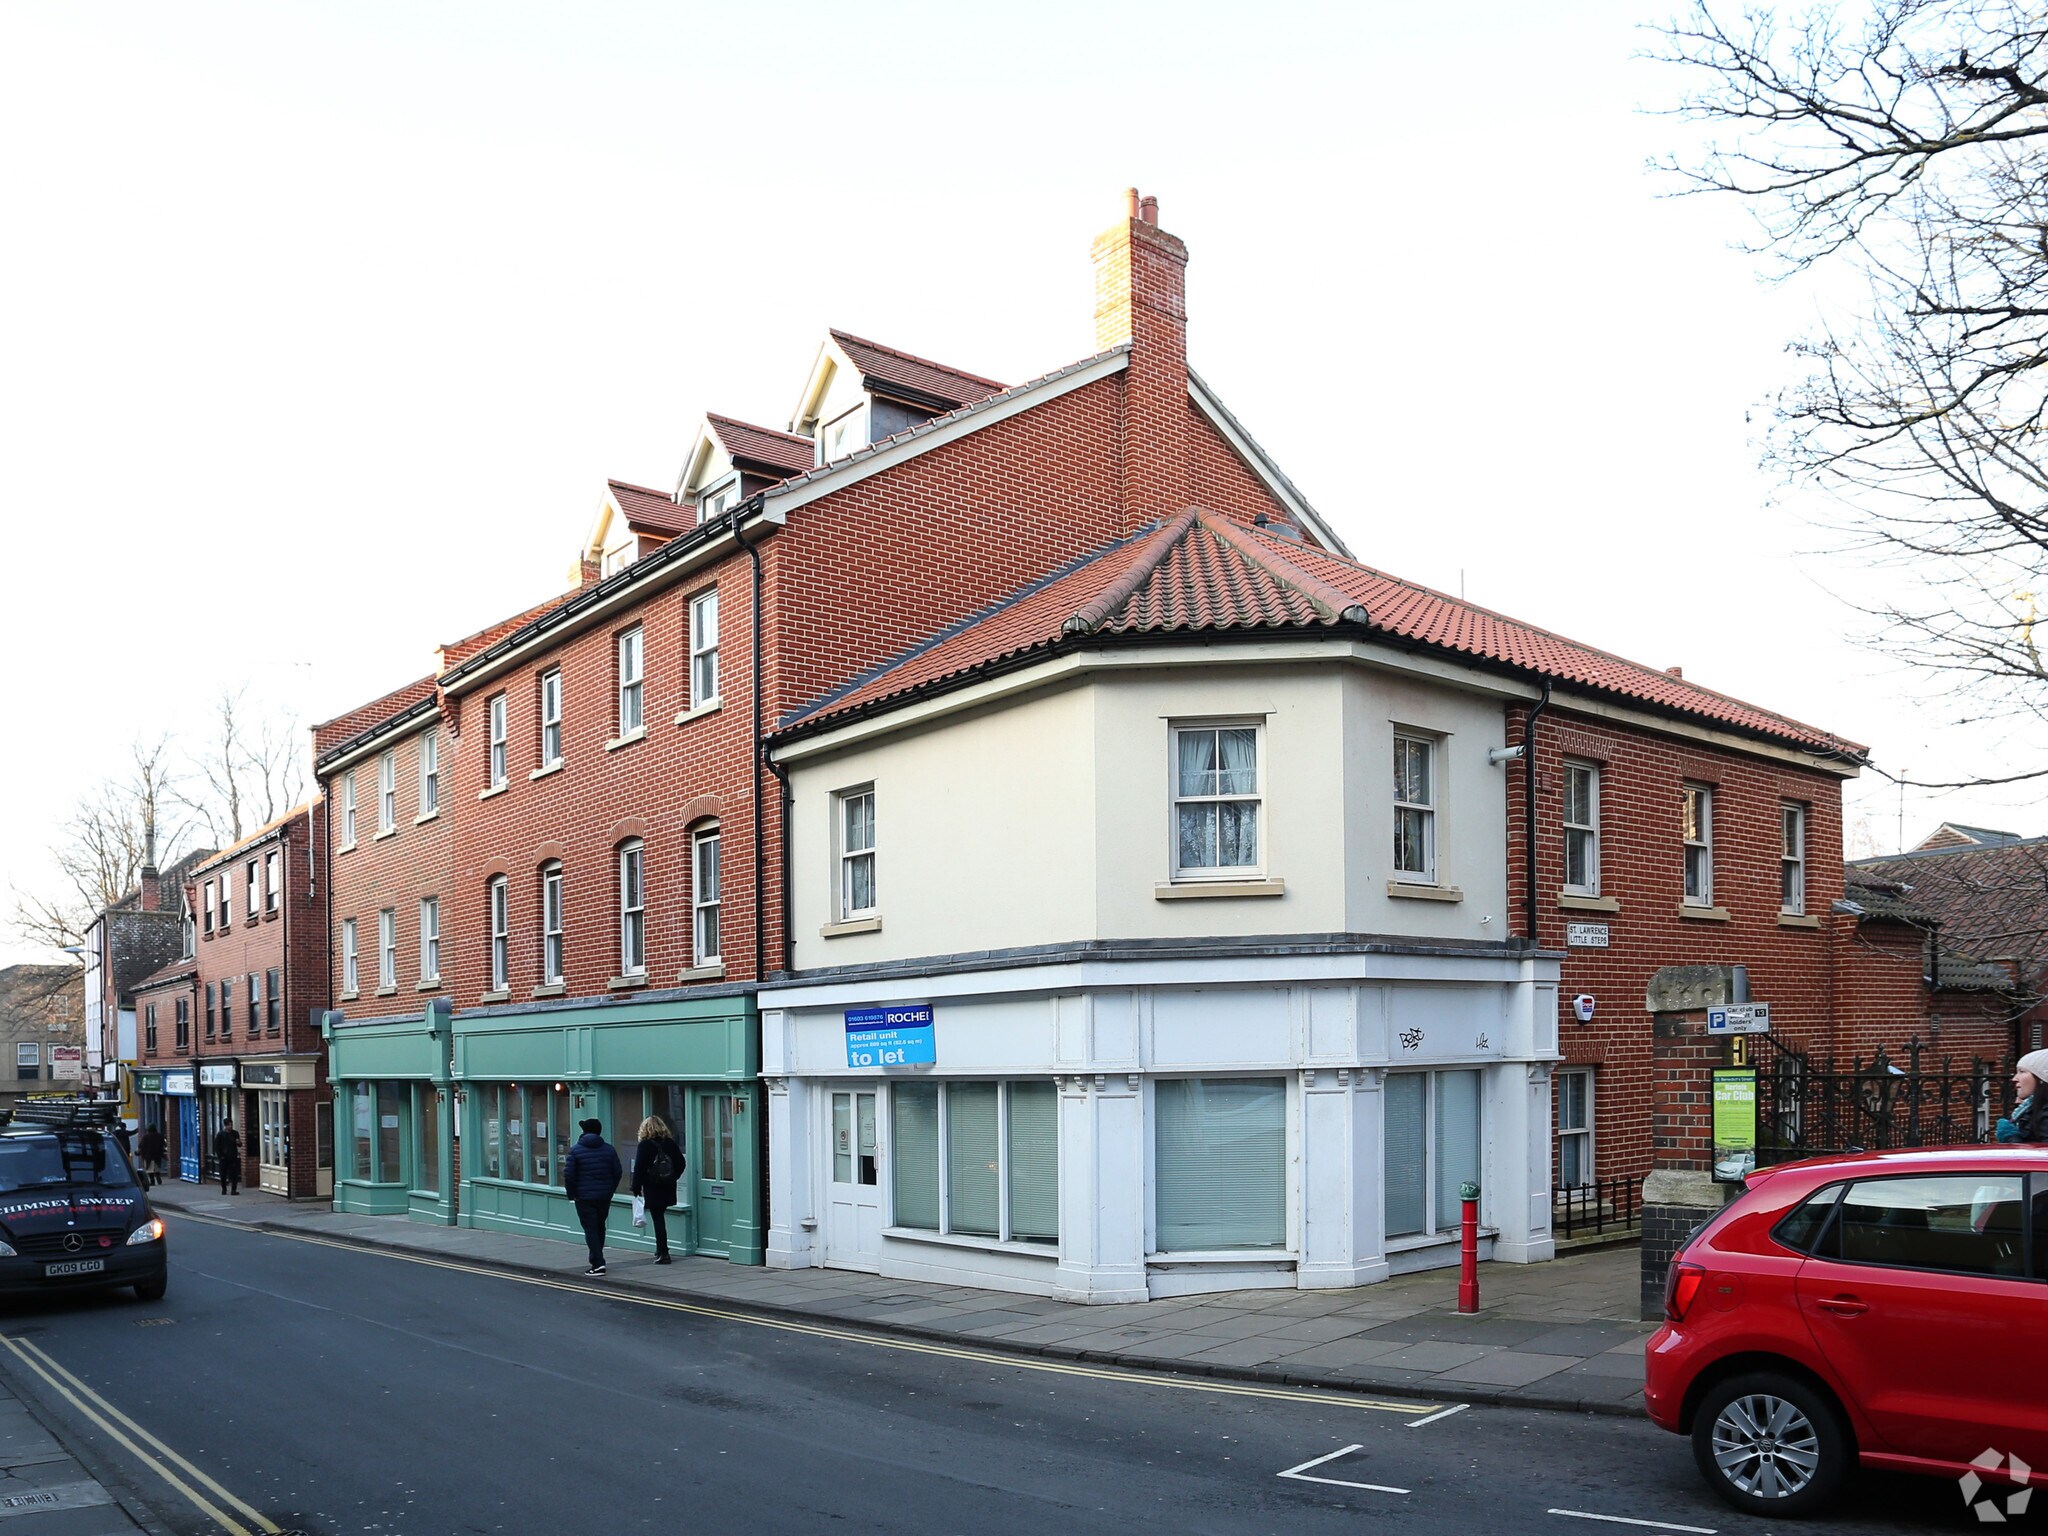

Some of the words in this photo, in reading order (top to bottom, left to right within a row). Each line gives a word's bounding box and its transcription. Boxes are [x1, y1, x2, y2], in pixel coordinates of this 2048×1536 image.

[1580, 927, 1607, 935] LAWRENCE
[888, 1012, 926, 1023] ROCHE
[1713, 1013, 1724, 1027] P
[850, 1033, 876, 1041] Retail
[880, 1031, 897, 1039] unit
[851, 1052, 872, 1066] to
[879, 1048, 904, 1063] let
[1715, 1090, 1731, 1101] Car
[1733, 1090, 1754, 1101] Club
[49, 1263, 77, 1275] GK09
[80, 1261, 100, 1271] CGO
